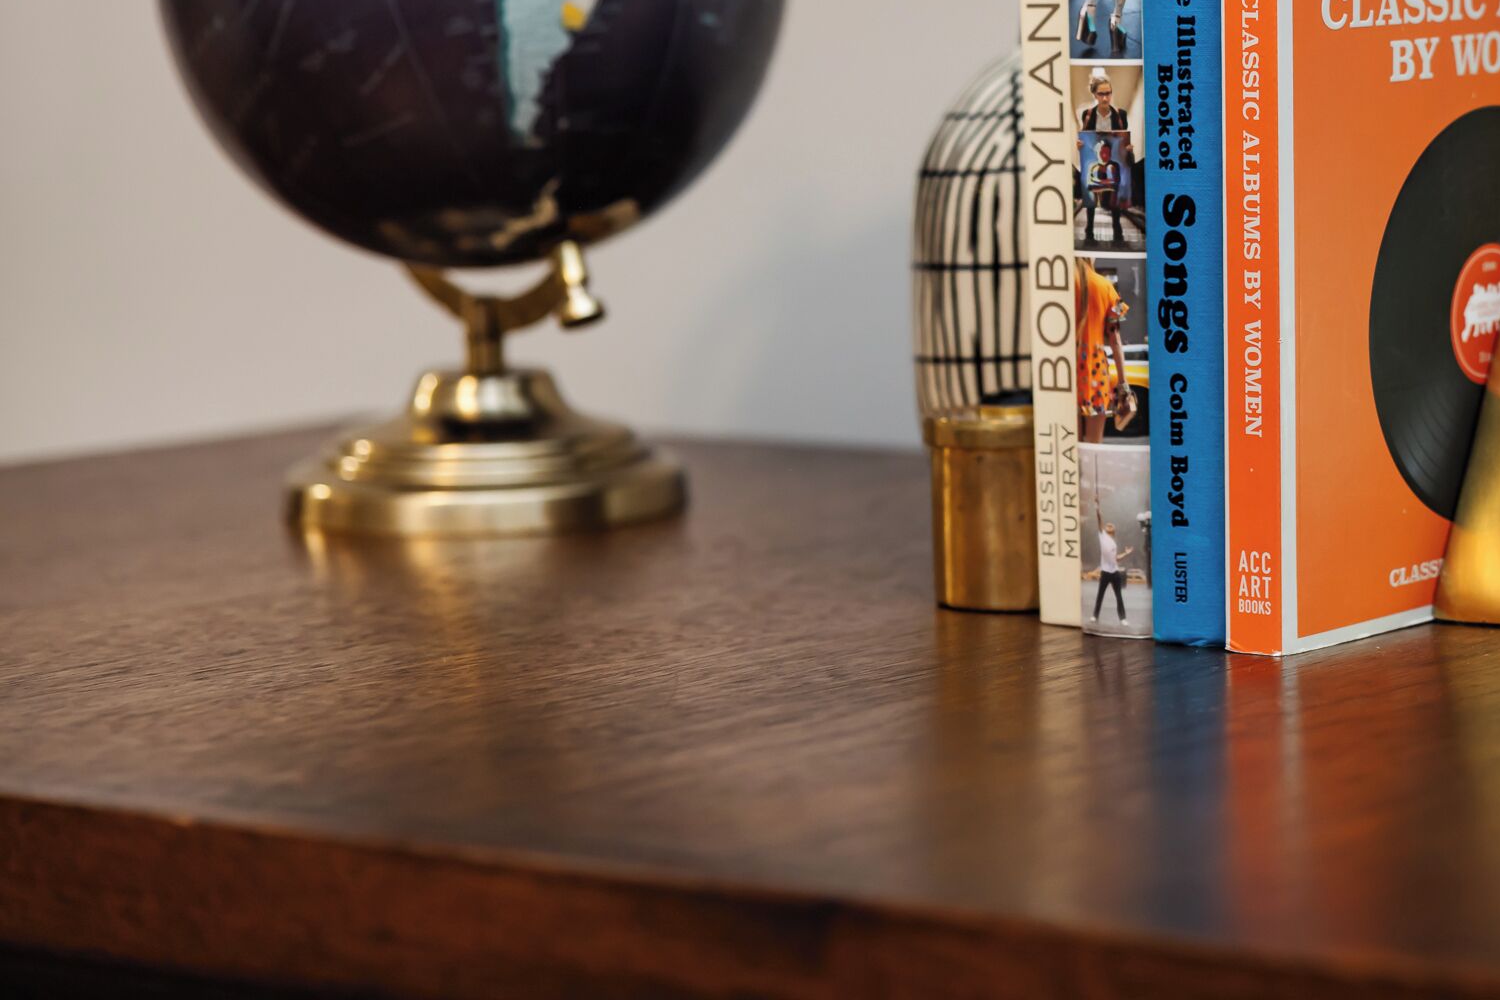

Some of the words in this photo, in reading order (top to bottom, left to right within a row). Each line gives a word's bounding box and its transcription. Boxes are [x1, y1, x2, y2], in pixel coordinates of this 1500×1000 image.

[1176, 15, 1197, 170] Illustrated
[1390, 37, 1440, 82] BY
[1026, 3, 1067, 225] DYLAN
[1157, 64, 1174, 137] Book
[1158, 141, 1175, 171] of
[1242, 130, 1262, 260] ALBUMS
[1158, 193, 1197, 354] Songs
[1243, 270, 1262, 310] BY
[1035, 254, 1072, 393] BOB
[1169, 373, 1188, 446] Colm
[1244, 320, 1263, 438] WOMEN
[1038, 423, 1056, 557] RUSSELL
[1061, 425, 1079, 559] MURRAY
[1168, 455, 1189, 528] Boyd
[1174, 552, 1188, 604] LUSTER
[1238, 550, 1271, 574] ACC
[1238, 574, 1272, 599] ART
[1389, 558, 1443, 588] CLASS
[1238, 598, 1272, 616] BOOKS
